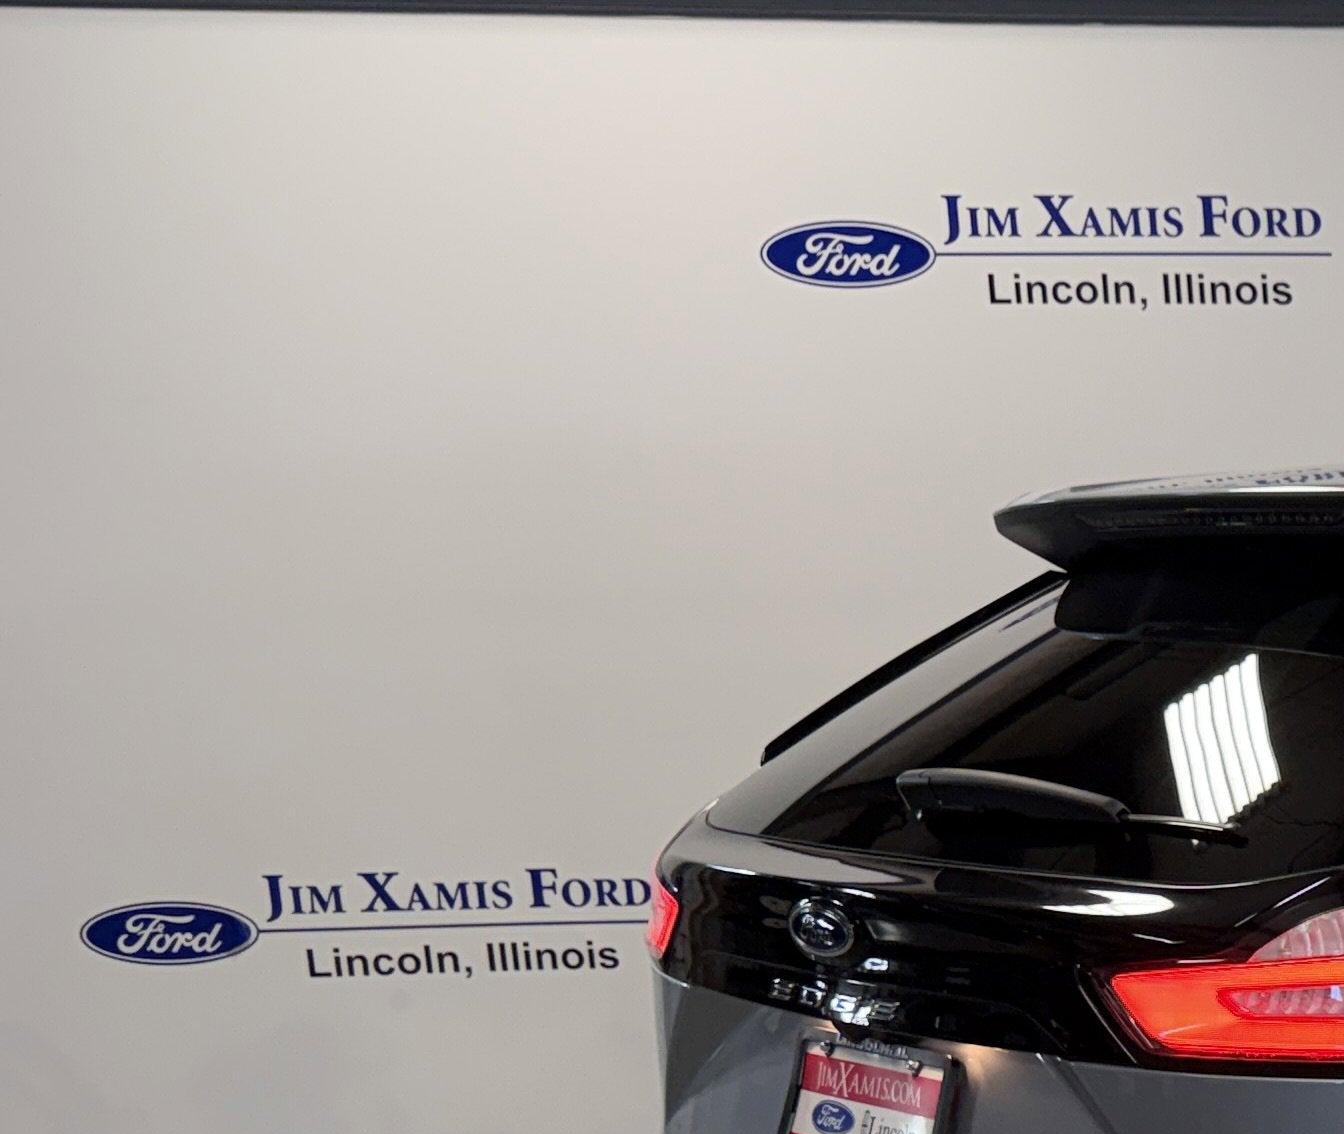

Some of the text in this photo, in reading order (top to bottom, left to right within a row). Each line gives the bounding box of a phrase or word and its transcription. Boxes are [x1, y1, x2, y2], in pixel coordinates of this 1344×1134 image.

[942, 195, 1321, 245] JIM XAMIS FORD
[797, 233, 900, 277] Ford
[988, 274, 1292, 310] Lincoln, Illinois
[262, 869, 651, 922] JIM XAMIS FORD
[117, 913, 222, 954] Ford
[306, 941, 619, 978] Lincoln, Illinois
[817, 1104, 845, 1130] Ford
